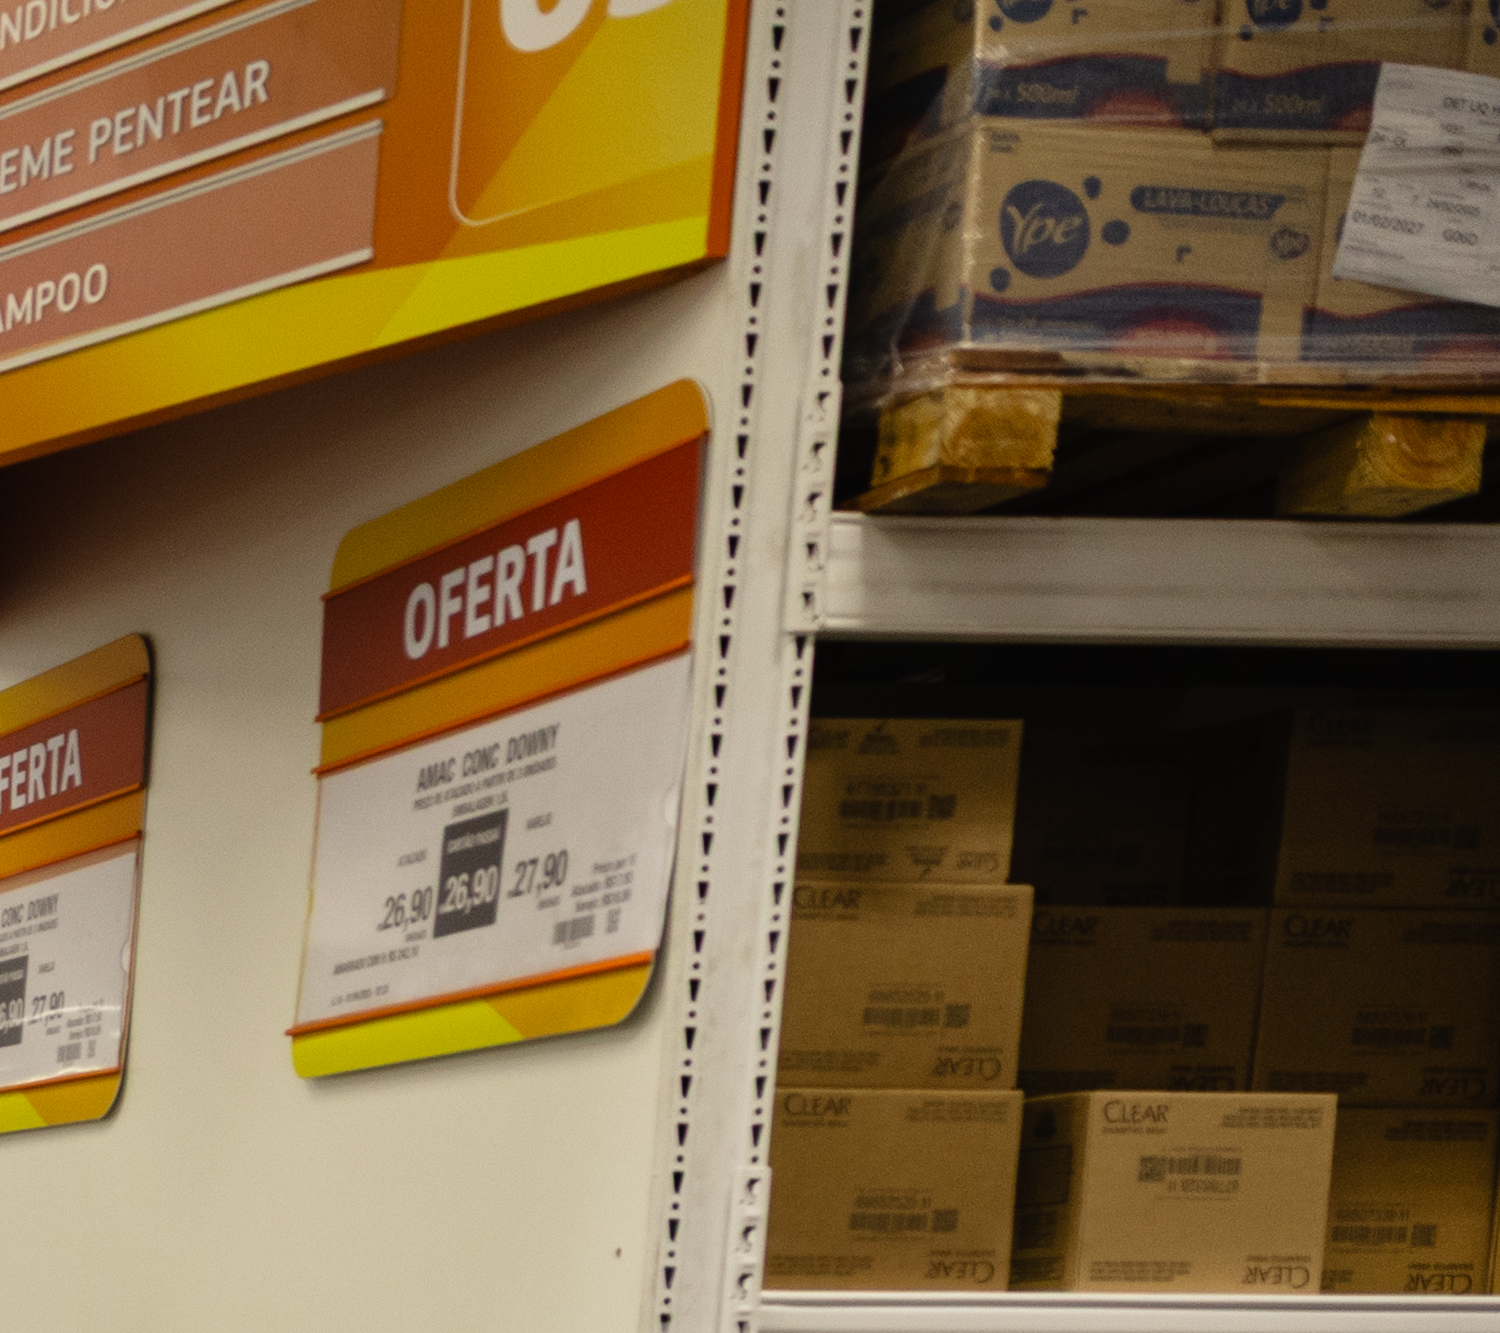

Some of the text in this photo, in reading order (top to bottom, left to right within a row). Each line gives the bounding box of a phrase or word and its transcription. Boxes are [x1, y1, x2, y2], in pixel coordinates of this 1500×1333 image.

[89, 59, 271, 164] PENTEAR
[403, 517, 589, 662] OFERTA
[416, 758, 456, 793] AMAC
[462, 743, 500, 778] CONC
[506, 722, 560, 765] DOWNY
[1103, 1101, 1169, 1126] CLEAR
